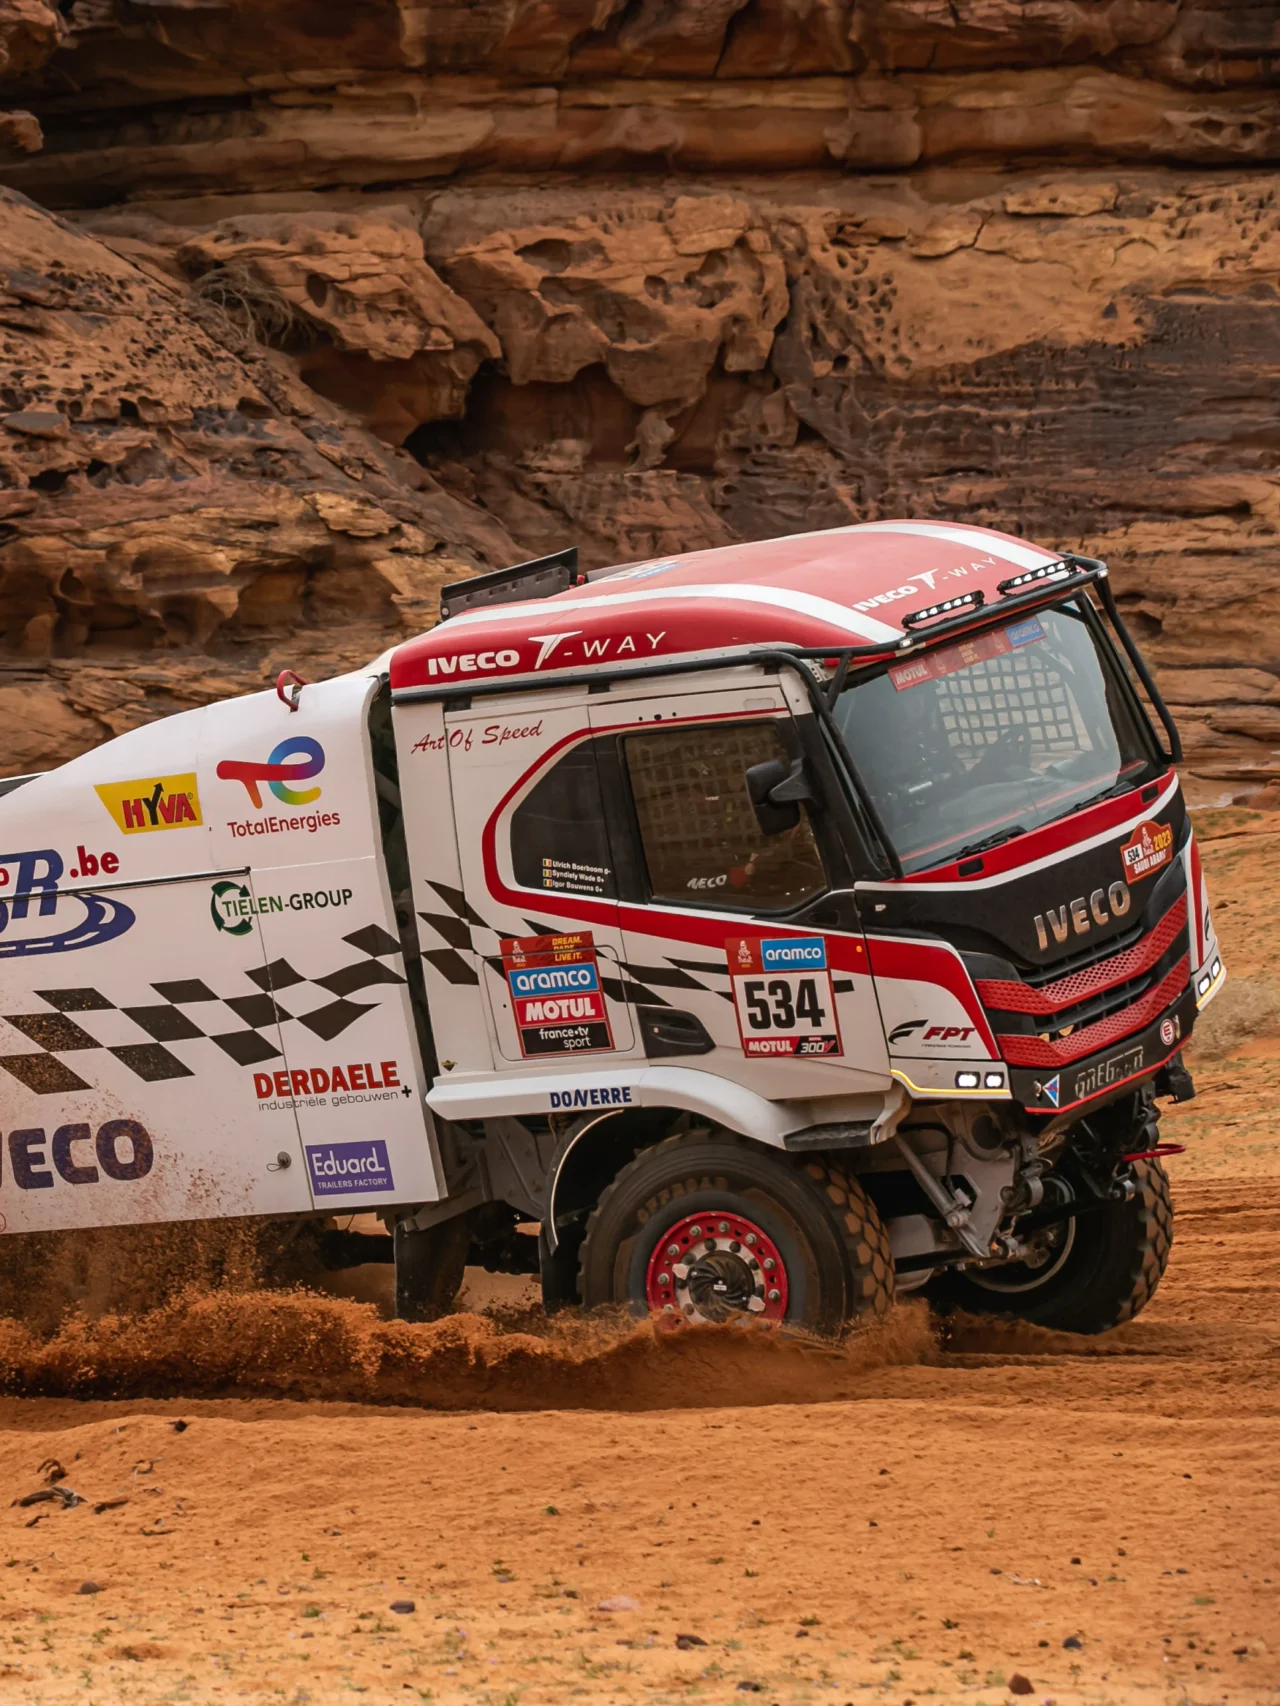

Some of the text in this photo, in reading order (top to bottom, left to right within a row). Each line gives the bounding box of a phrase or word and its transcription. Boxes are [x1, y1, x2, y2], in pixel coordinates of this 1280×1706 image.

[852, 585, 919, 612] IVECO
[427, 649, 520, 676] IVECO
[894, 664, 928, 685] MOTUL
[411, 719, 543, 755] Art Of Speed
[227, 810, 341, 838] TotalEnergies
[1127, 846, 1140, 863] 534
[1153, 829, 1171, 852] 2023
[222, 888, 353, 918] TIELEN-GROUP
[1033, 880, 1131, 951] IVECO
[554, 952, 573, 962] LIVE
[765, 947, 822, 961] aramco
[516, 969, 591, 991] aramco
[525, 997, 596, 1022] MOTUL
[744, 978, 826, 1030] 534
[563, 1036, 591, 1051] sport
[748, 1040, 836, 1053] MOTUL 300V
[922, 1026, 976, 1041] FPT
[253, 1061, 401, 1099] DERDAELE
[258, 1090, 399, 1111] industriële gebouwen
[311, 1147, 386, 1176] Eduard
[317, 1177, 387, 1189] TRAILERS FACTORY
